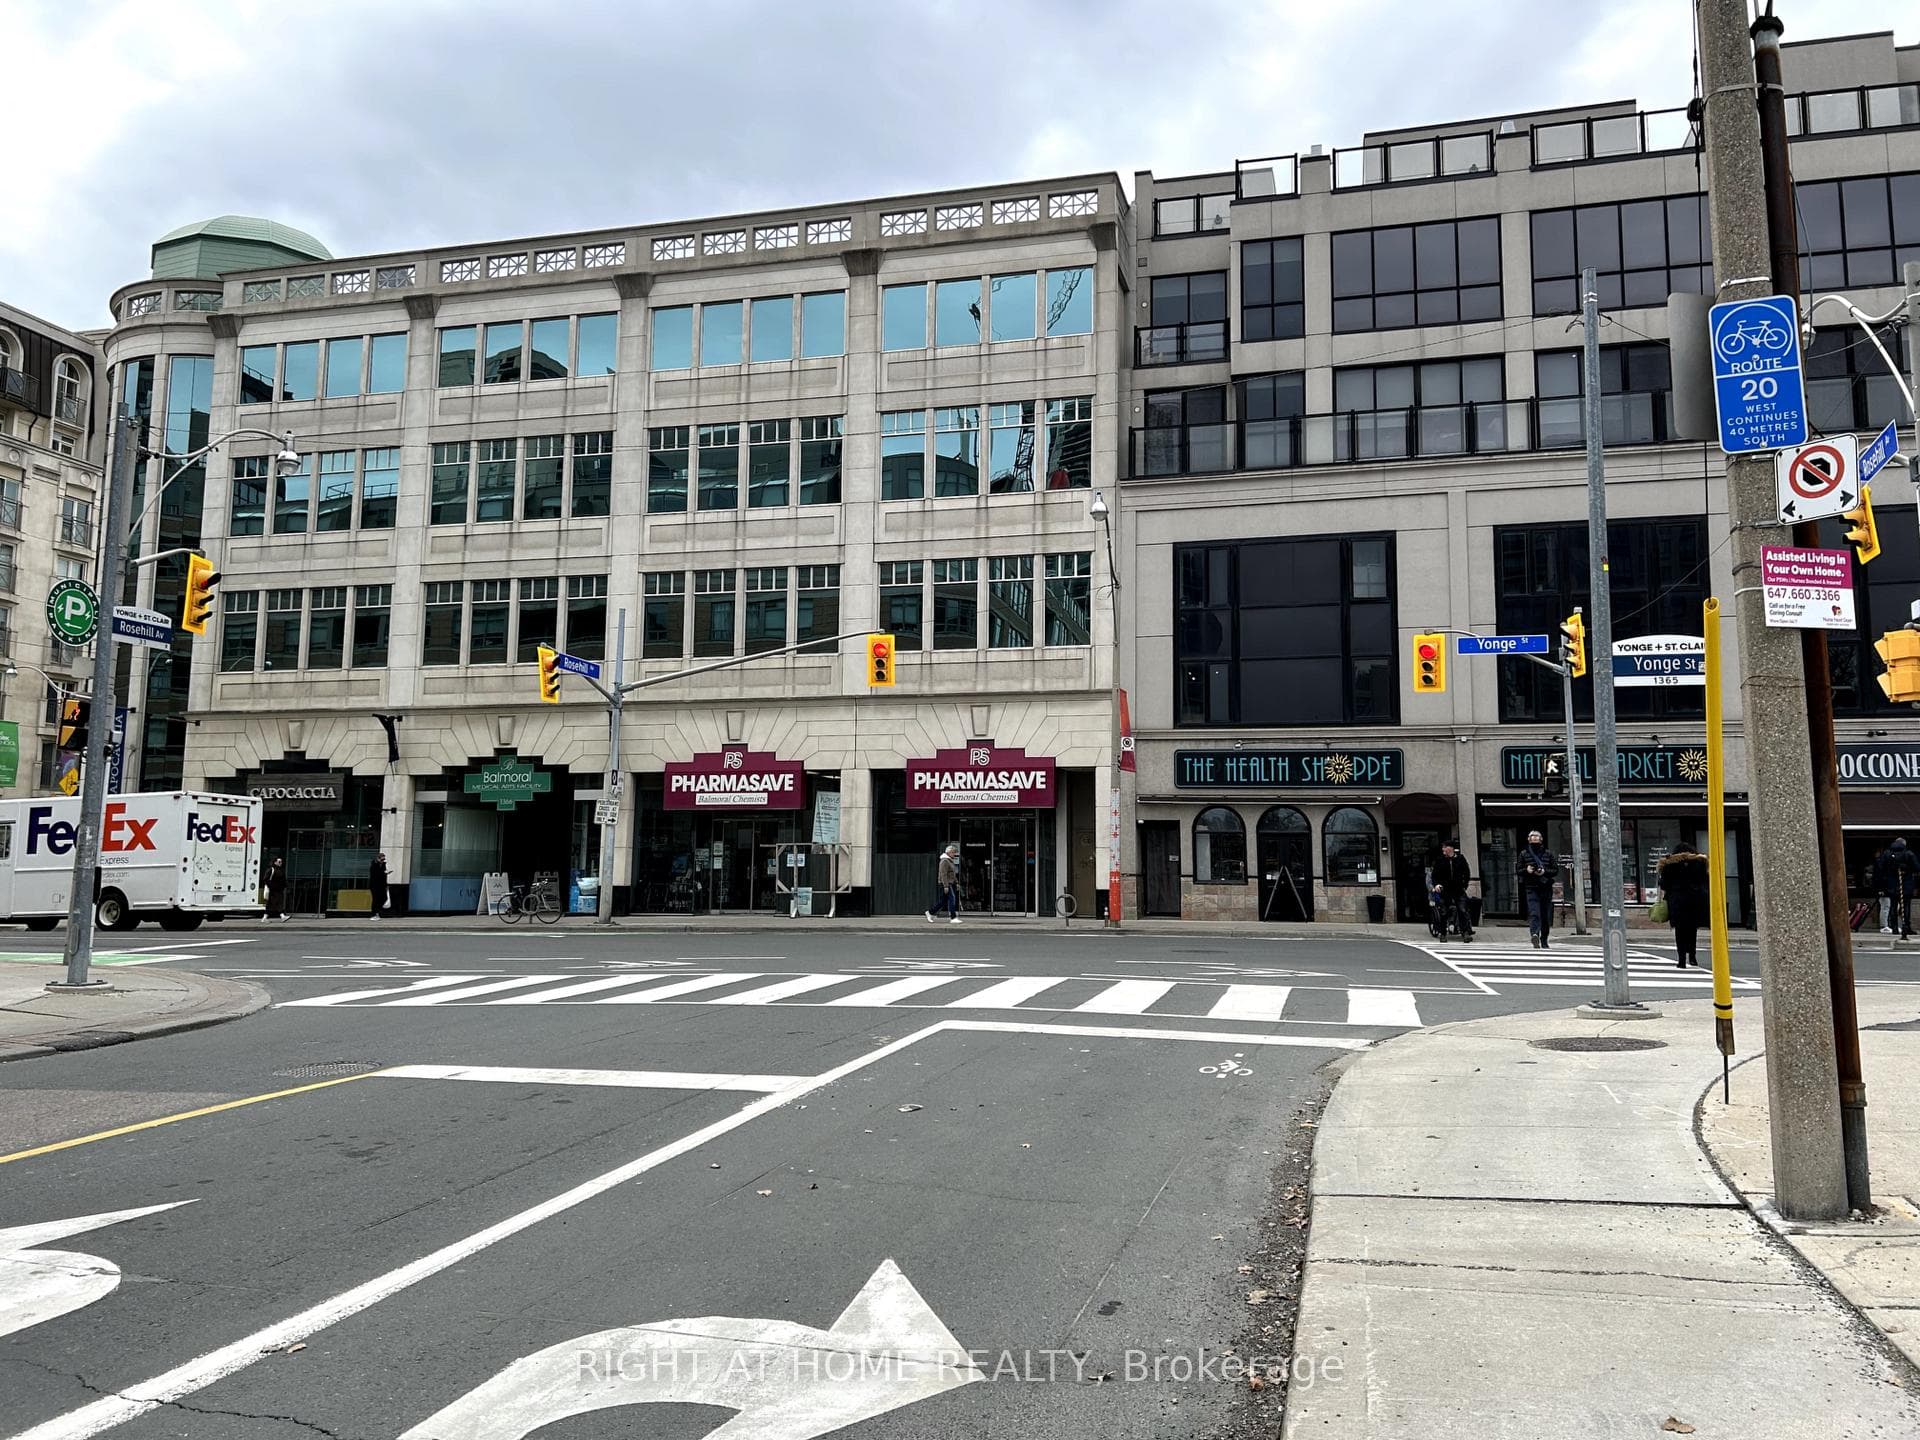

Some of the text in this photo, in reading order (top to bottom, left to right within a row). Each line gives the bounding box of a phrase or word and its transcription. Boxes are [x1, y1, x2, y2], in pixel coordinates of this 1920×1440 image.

[1731, 357, 1782, 374] ROUTE
[1741, 377, 1778, 401] 20
[1745, 403, 1777, 413] WEST
[1727, 411, 1798, 426] CONTINUES
[1730, 422, 1798, 437] 40 METRES
[1743, 433, 1785, 445] SOUTH
[1766, 551, 1846, 566] Assisted Living in
[1766, 563, 1845, 577] Your Own Home.
[50, 583, 99, 615] MUNICIPAL
[1767, 587, 1841, 601] 647.660.3366
[64, 595, 87, 621] P
[116, 608, 137, 619] YONGE
[49, 612, 98, 642] PARKING
[120, 620, 165, 640] Rosehill Av
[1477, 637, 1529, 651] Yonge St
[1617, 644, 1653, 652] YONGE
[1664, 643, 1678, 651] ST.
[1679, 643, 1705, 651] CLAI
[564, 657, 589, 674] Rosehill
[1634, 656, 1696, 674] Yonge St
[1654, 676, 1679, 685] 1365
[1184, 758, 1214, 782] THE
[1225, 756, 1289, 782] HEALTH
[1616, 752, 1674, 779] ARKET
[483, 771, 532, 783] Balmoral
[671, 773, 794, 792] PHARMASAVE
[914, 771, 1047, 790] PHARMASAVE
[250, 787, 336, 799] CAPOCACCIA
[698, 794, 767, 803] Balmoral Chemists
[943, 792, 1017, 801] Balmoral Chemists
[26, 803, 159, 855] FeEx
[187, 812, 257, 844] FedEx
[100, 856, 129, 865] Express
